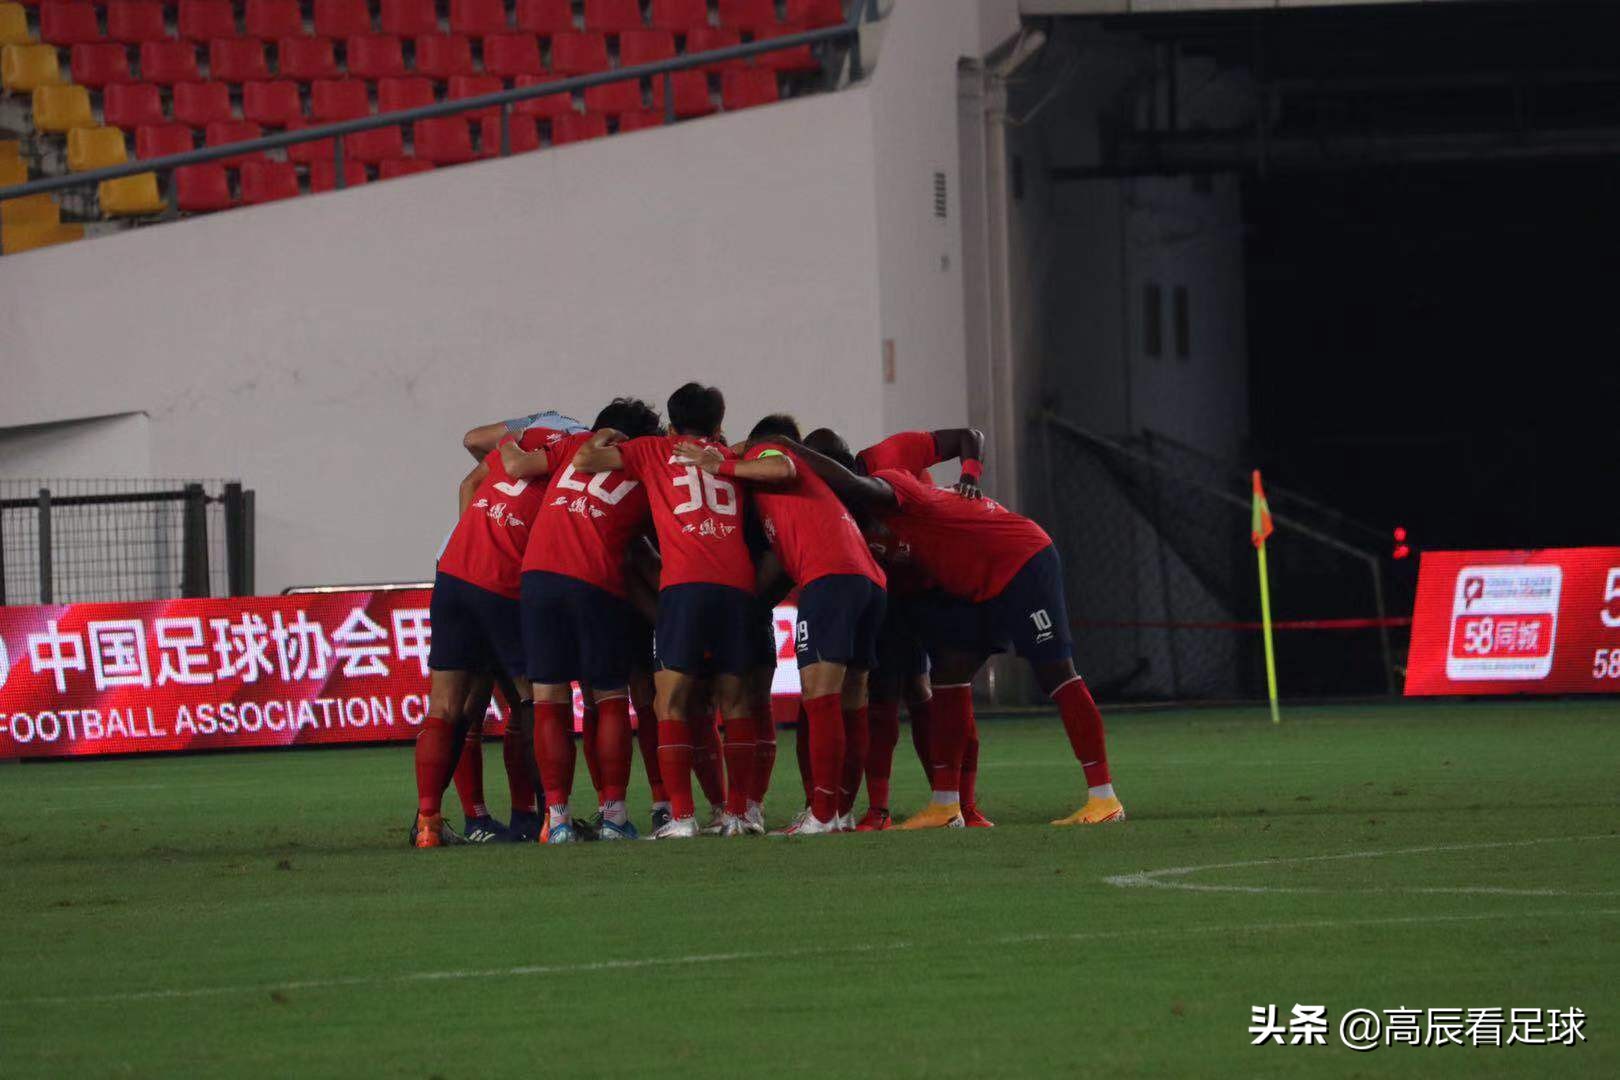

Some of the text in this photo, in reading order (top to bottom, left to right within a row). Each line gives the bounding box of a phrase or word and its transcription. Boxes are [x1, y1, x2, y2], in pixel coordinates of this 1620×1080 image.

[667, 454, 737, 515] 36
[1030, 608, 1053, 631] 10
[174, 695, 393, 736] ASSOCIATION
